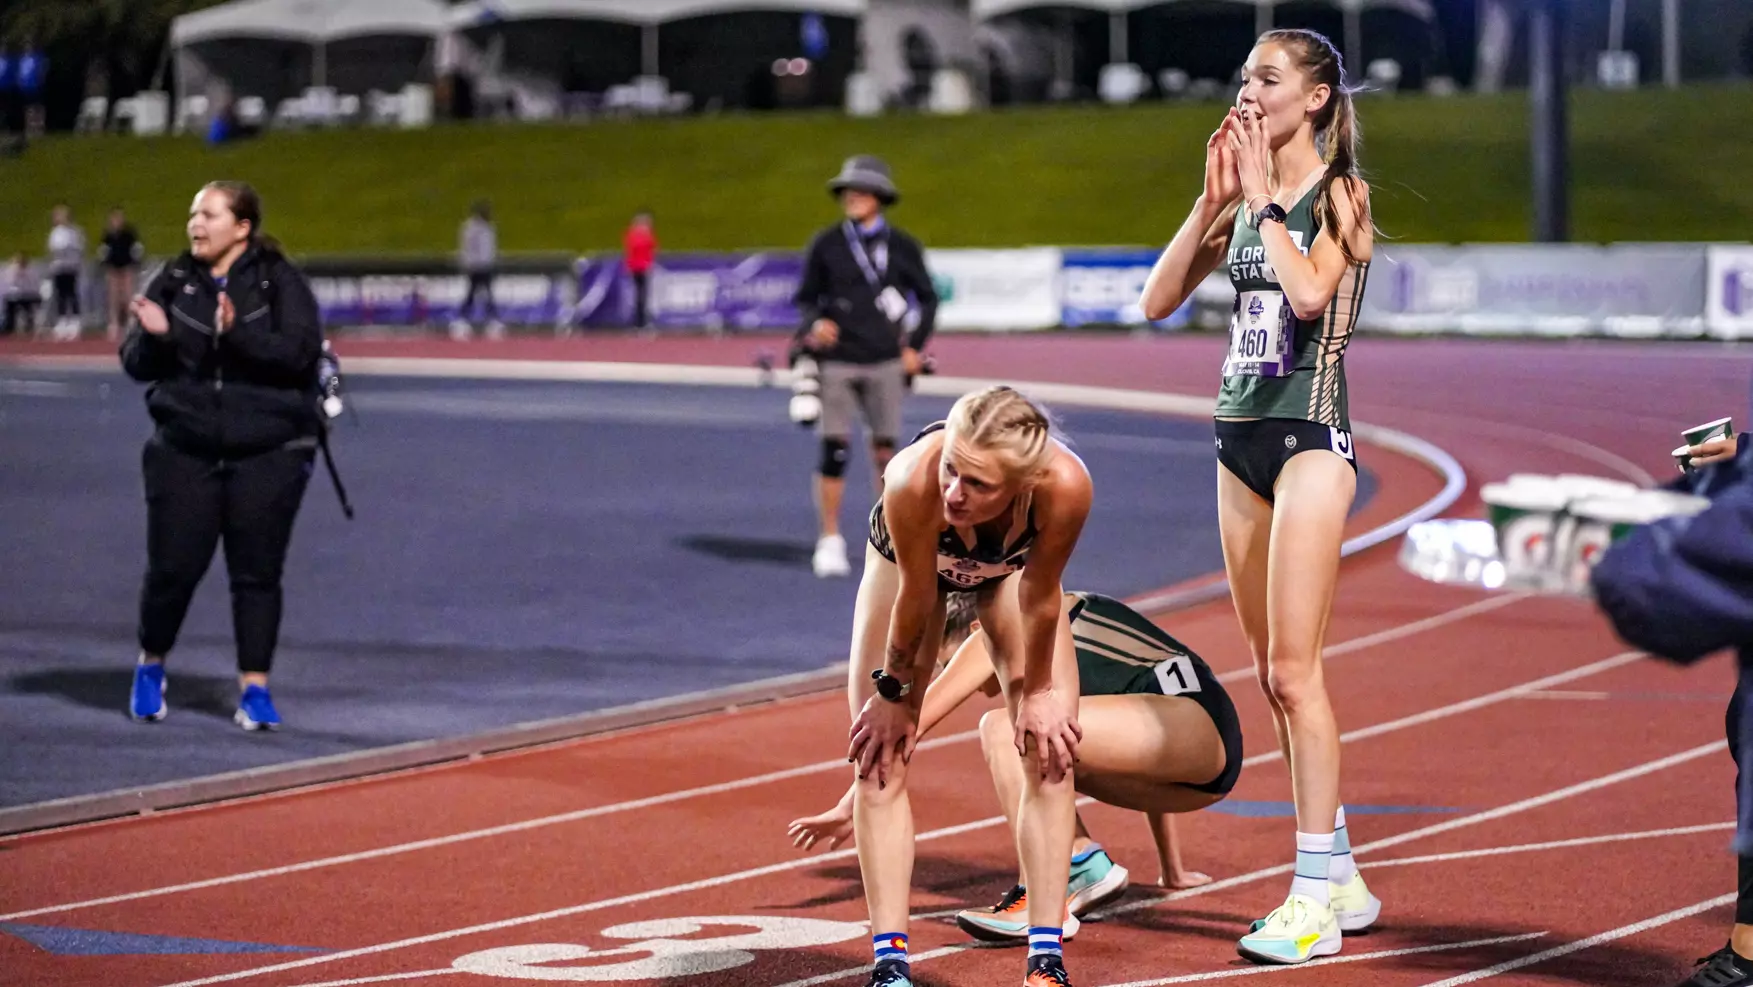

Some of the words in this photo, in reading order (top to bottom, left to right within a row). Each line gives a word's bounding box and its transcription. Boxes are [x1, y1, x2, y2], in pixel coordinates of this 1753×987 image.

[1231, 262, 1266, 282] STAT
[1238, 328, 1268, 358] 460
[1166, 661, 1188, 689] 1
[451, 915, 869, 982] 3
